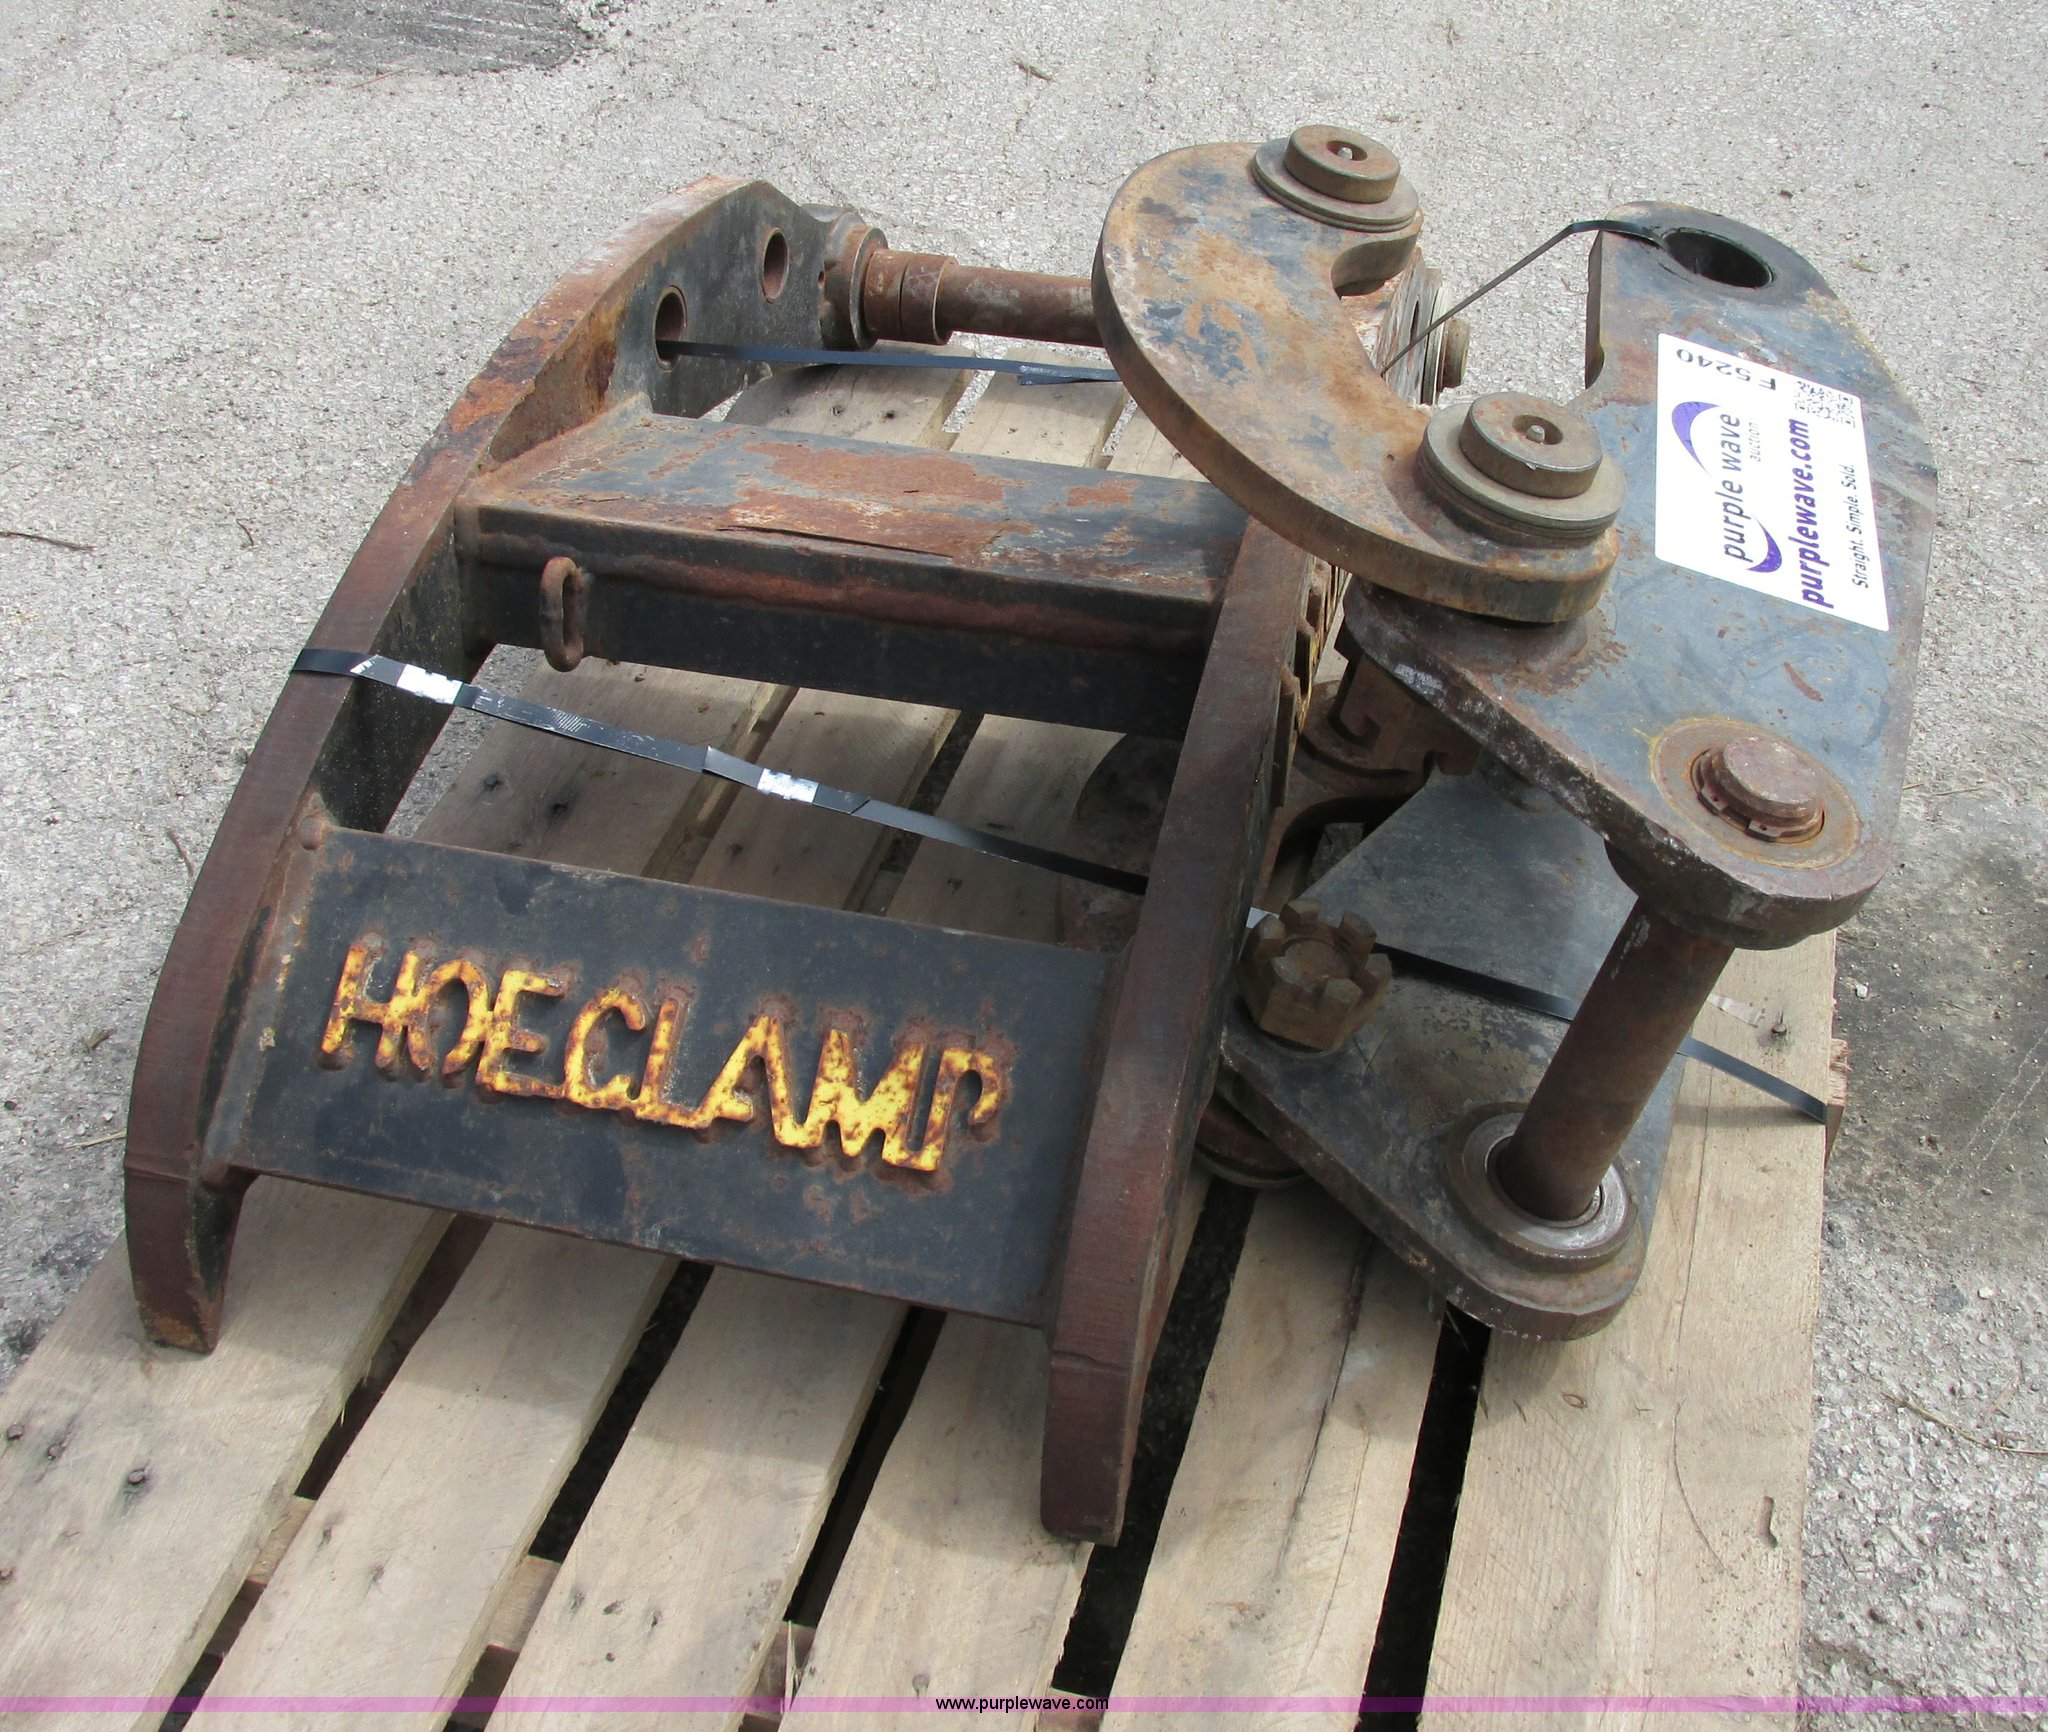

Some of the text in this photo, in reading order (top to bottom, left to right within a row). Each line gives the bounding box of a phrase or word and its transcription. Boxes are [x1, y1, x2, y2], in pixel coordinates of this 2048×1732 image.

[1715, 413, 1754, 563] purple wave
[1748, 422, 1762, 462] auction
[1787, 418, 1835, 609] purplewave.com
[1838, 464, 1869, 588] Straight. Simple. Sold.
[319, 942, 1010, 1172] HOECLAMP
